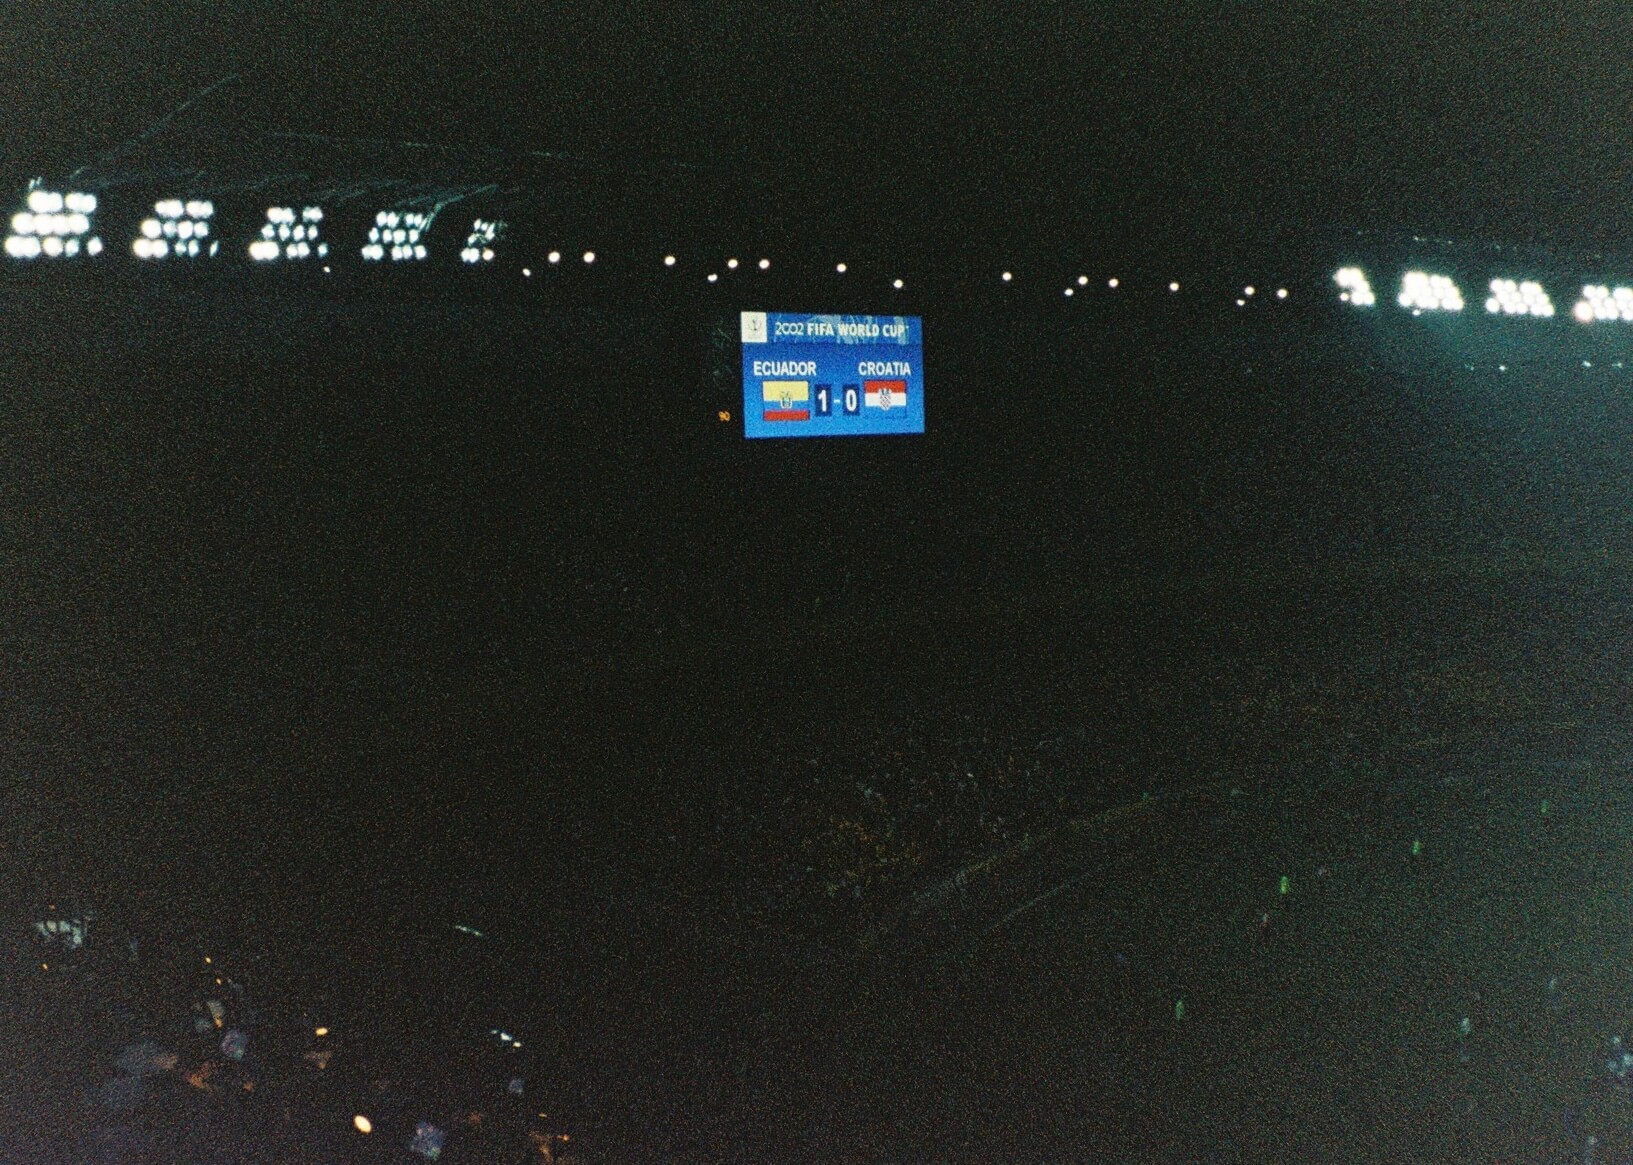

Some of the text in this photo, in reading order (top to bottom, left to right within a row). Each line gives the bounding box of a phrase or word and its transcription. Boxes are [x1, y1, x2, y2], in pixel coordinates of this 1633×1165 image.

[775, 321, 905, 337] 2002 FIFA WORLD CUP
[753, 361, 817, 376] ECUADOR
[858, 361, 911, 376] CROATIA
[818, 389, 827, 412] 1
[845, 389, 857, 411] 0
